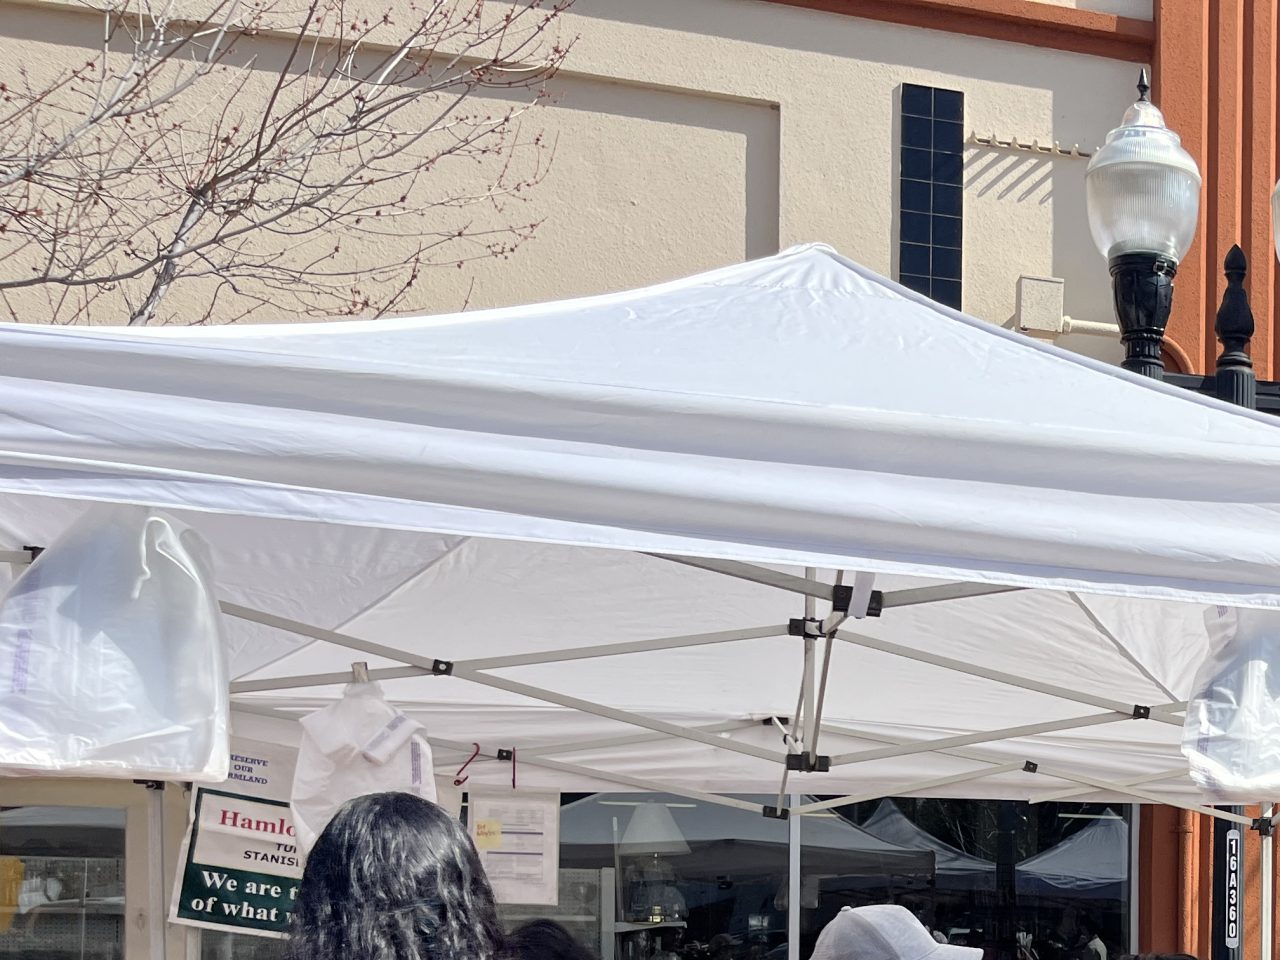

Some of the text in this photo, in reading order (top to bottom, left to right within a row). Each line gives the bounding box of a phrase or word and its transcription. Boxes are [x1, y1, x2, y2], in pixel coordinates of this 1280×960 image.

[228, 772, 268, 785] RMLAND
[218, 809, 297, 838] Hamlo
[202, 870, 238, 891] We
[245, 881, 282, 898] are
[1228, 840, 1237, 937] 16A360
[191, 896, 218, 912] of
[222, 901, 279, 922] what
